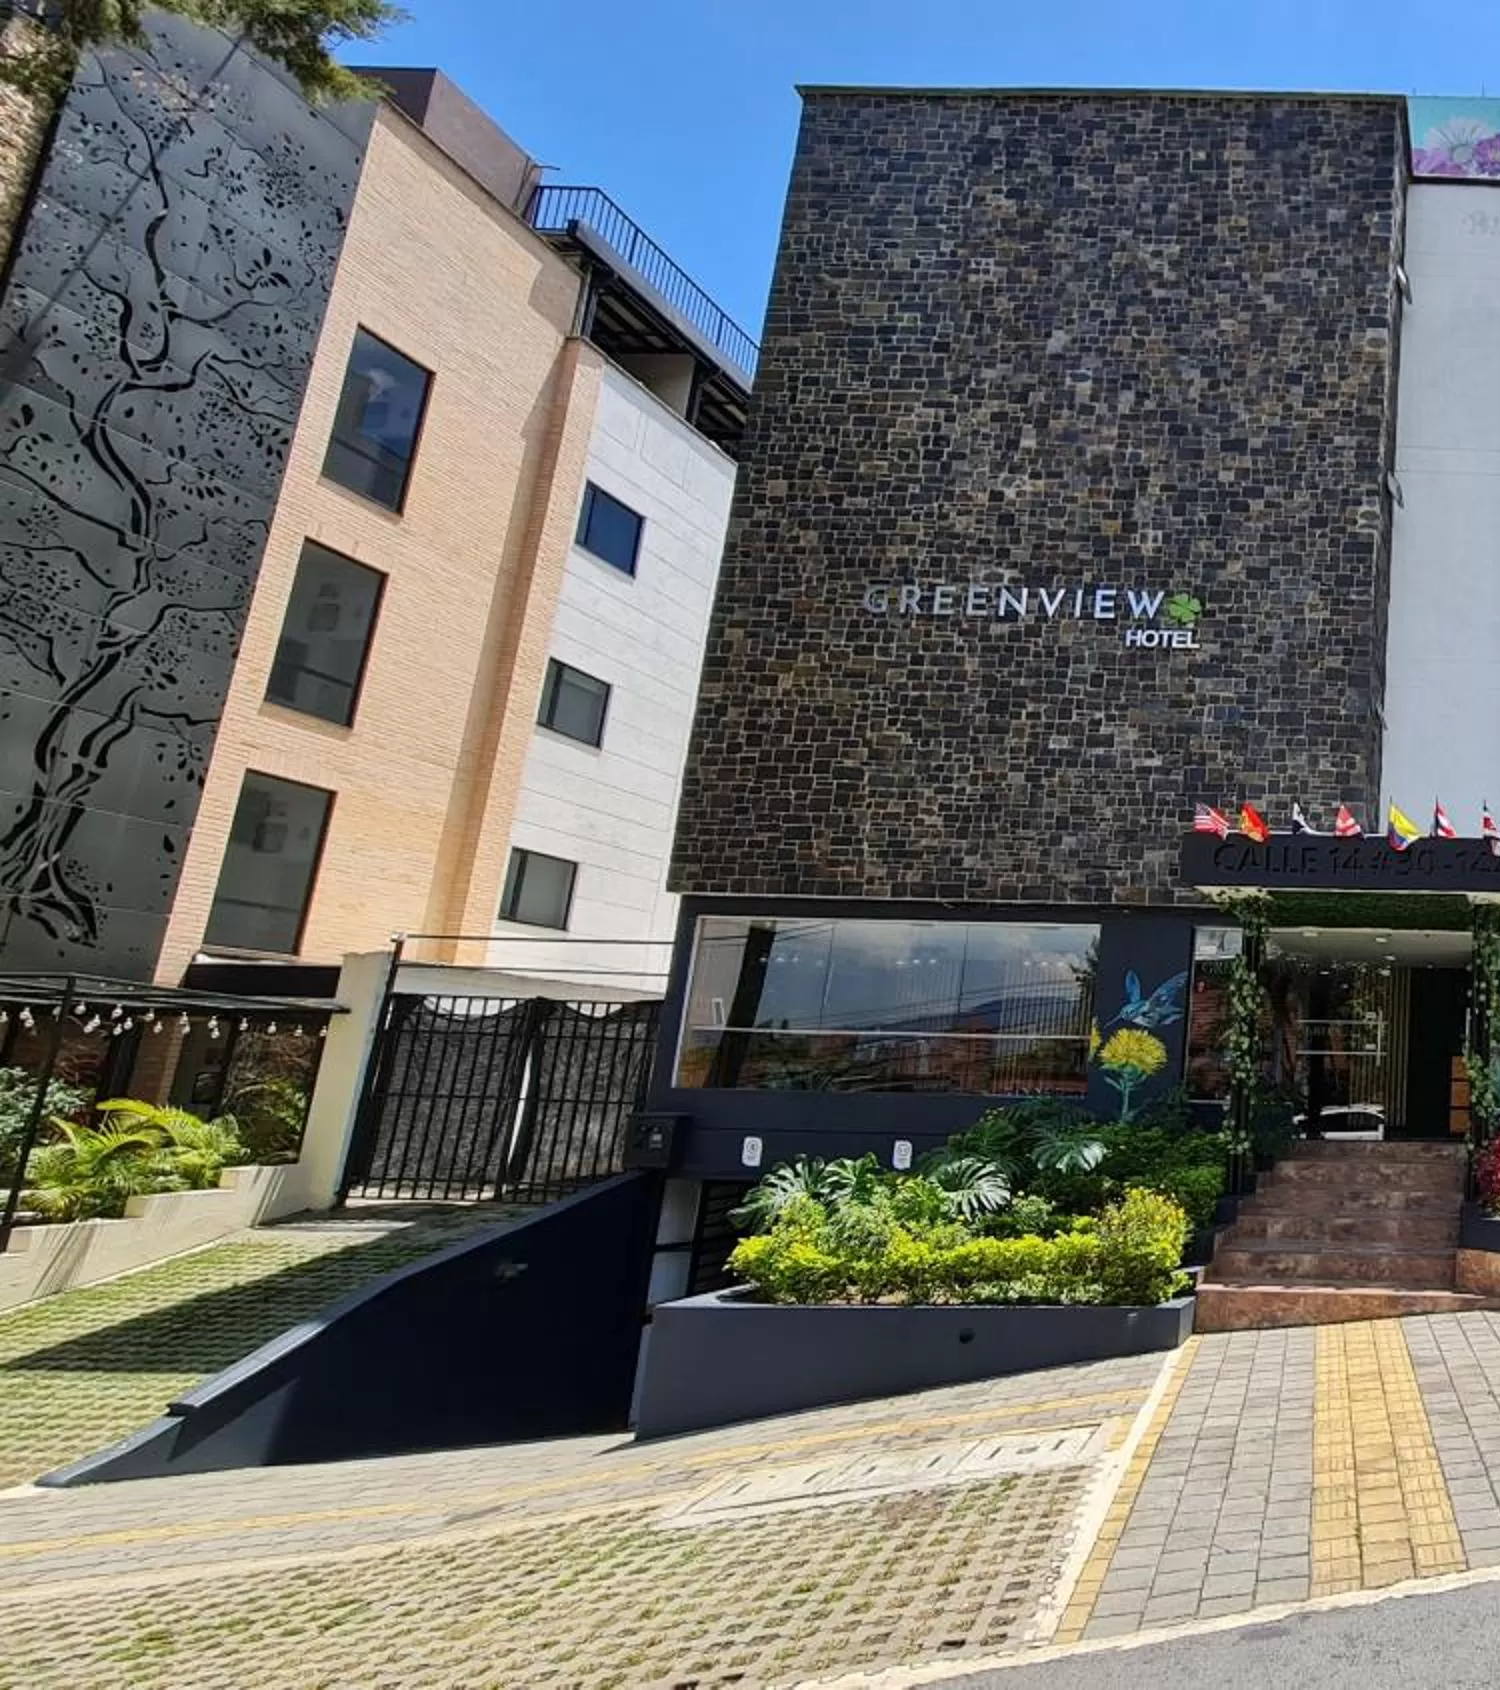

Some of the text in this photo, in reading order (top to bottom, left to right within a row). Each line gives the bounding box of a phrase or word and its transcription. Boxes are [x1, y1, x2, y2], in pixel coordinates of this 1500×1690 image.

[863, 585, 1165, 619] GREENVIEW
[1125, 629, 1200, 649] HOTEL
[1213, 843, 1318, 875] CALLE
[1329, 845, 1365, 877] 14
